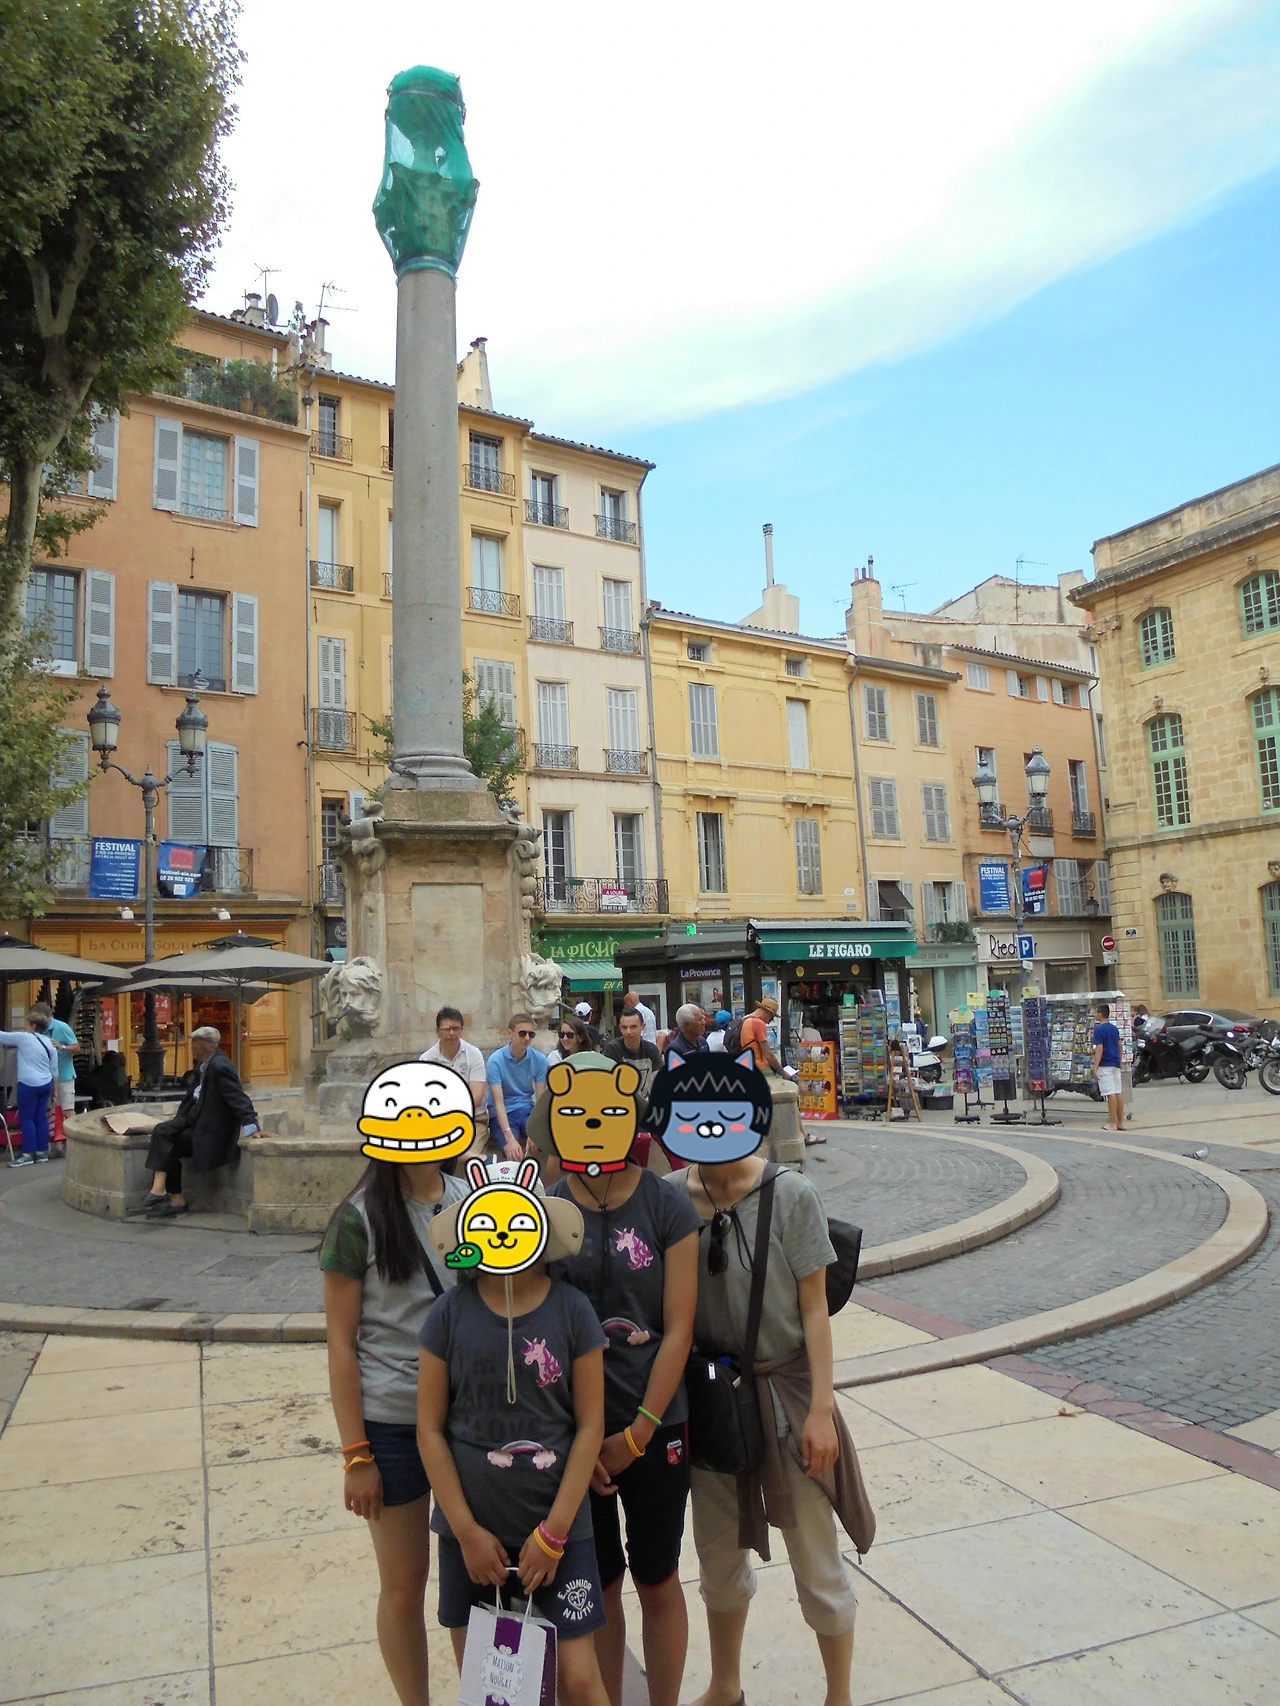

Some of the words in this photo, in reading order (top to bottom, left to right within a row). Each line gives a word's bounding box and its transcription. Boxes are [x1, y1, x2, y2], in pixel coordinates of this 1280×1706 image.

[95, 842, 136, 852] FESTIVAL
[89, 940, 106, 950] LA
[809, 945, 824, 957] LE
[827, 944, 872, 957] FIGARO
[1022, 940, 1030, 955] P
[551, 947, 566, 958] LA
[681, 969, 689, 977] La
[690, 968, 721, 976] Provence
[603, 981, 614, 989] EN
[563, 1601, 594, 1620] NAUTIC
[492, 1655, 515, 1673] MAISON
[489, 1672, 512, 1690] NOUGAT
